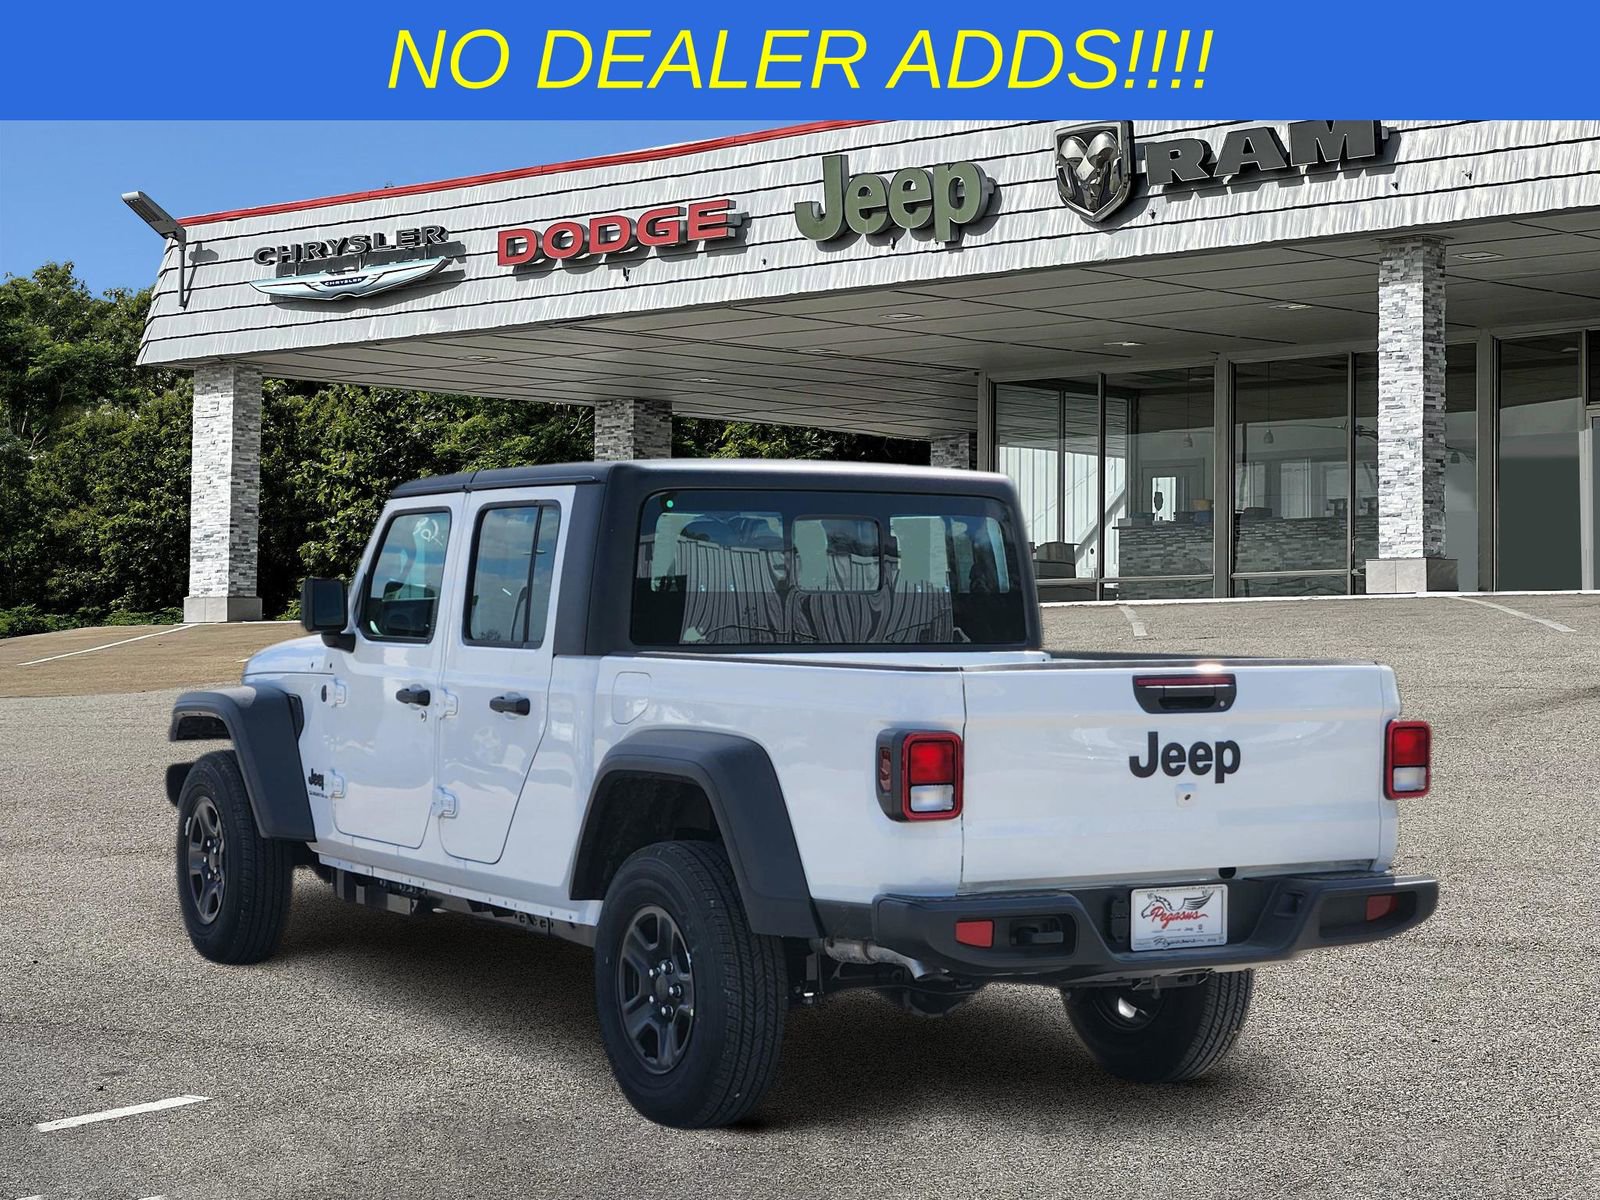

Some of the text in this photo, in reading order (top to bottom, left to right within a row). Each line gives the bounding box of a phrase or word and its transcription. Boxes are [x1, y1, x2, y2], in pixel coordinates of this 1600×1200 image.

[1146, 119, 1377, 185] RAM
[795, 154, 989, 242] Jeep
[253, 225, 447, 266] CHRYSLER
[497, 199, 734, 266] DODGE
[324, 276, 363, 287] CHRYSLER
[308, 768, 324, 791] Jeep
[1129, 731, 1241, 784] Jeep
[1151, 906, 1208, 929] Pegasus
